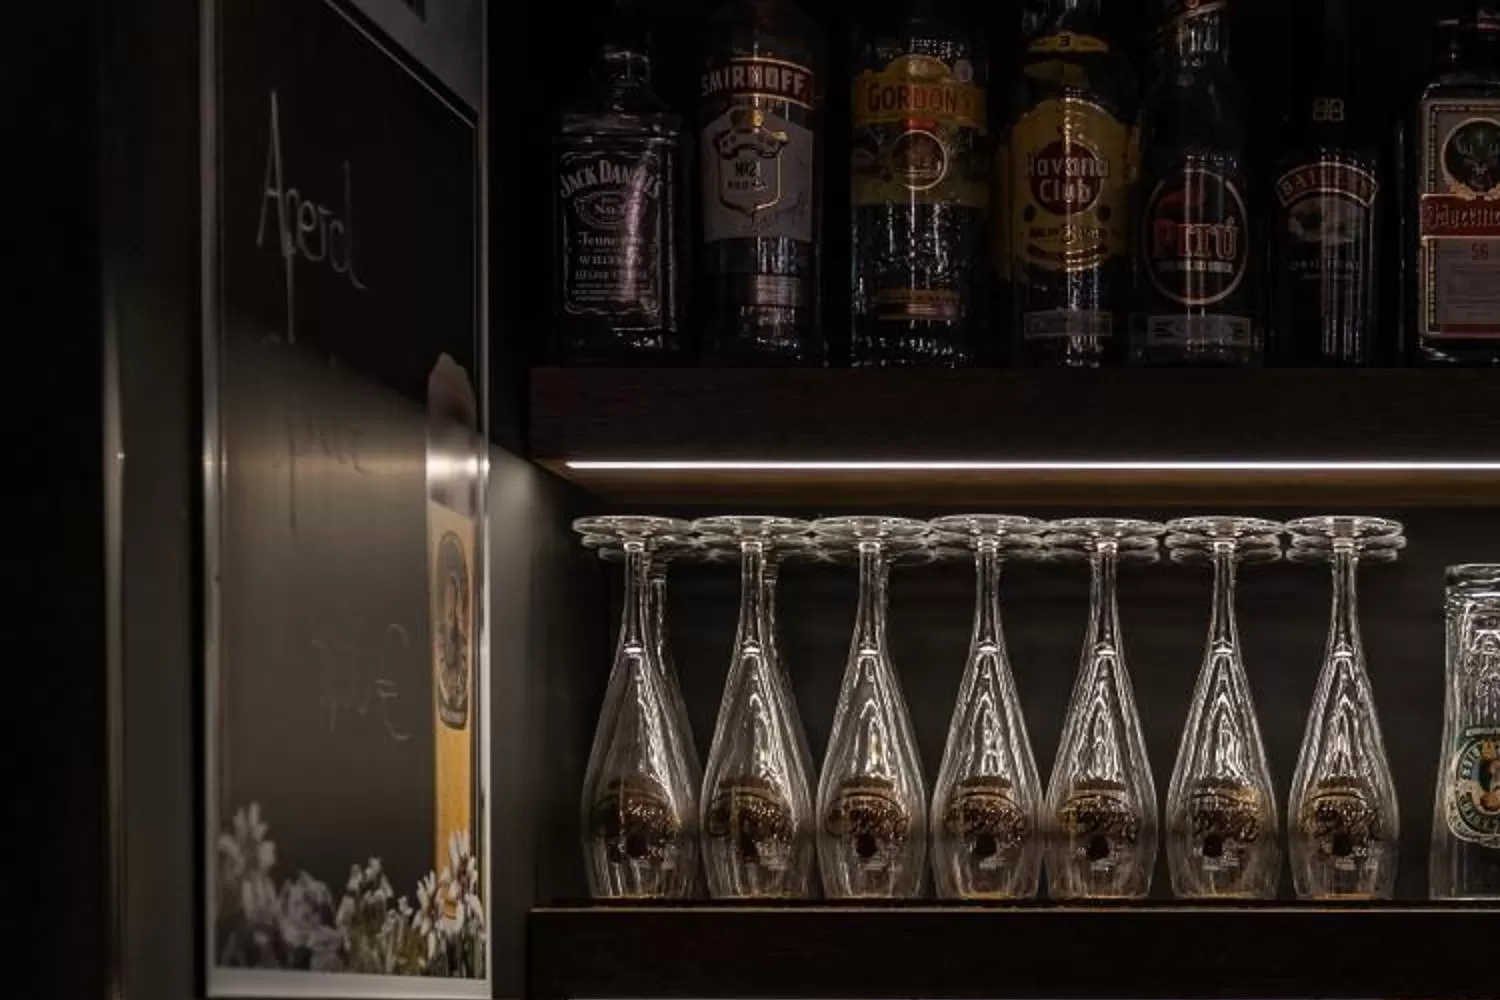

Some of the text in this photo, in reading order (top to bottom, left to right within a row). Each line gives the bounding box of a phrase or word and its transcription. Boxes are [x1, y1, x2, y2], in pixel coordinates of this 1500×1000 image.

[701, 63, 807, 97] SMIRNOFF
[1026, 151, 1109, 177] Havana
[559, 163, 599, 200] JACK
[1038, 178, 1093, 204] Club
[1151, 215, 1240, 261] PITÚ
